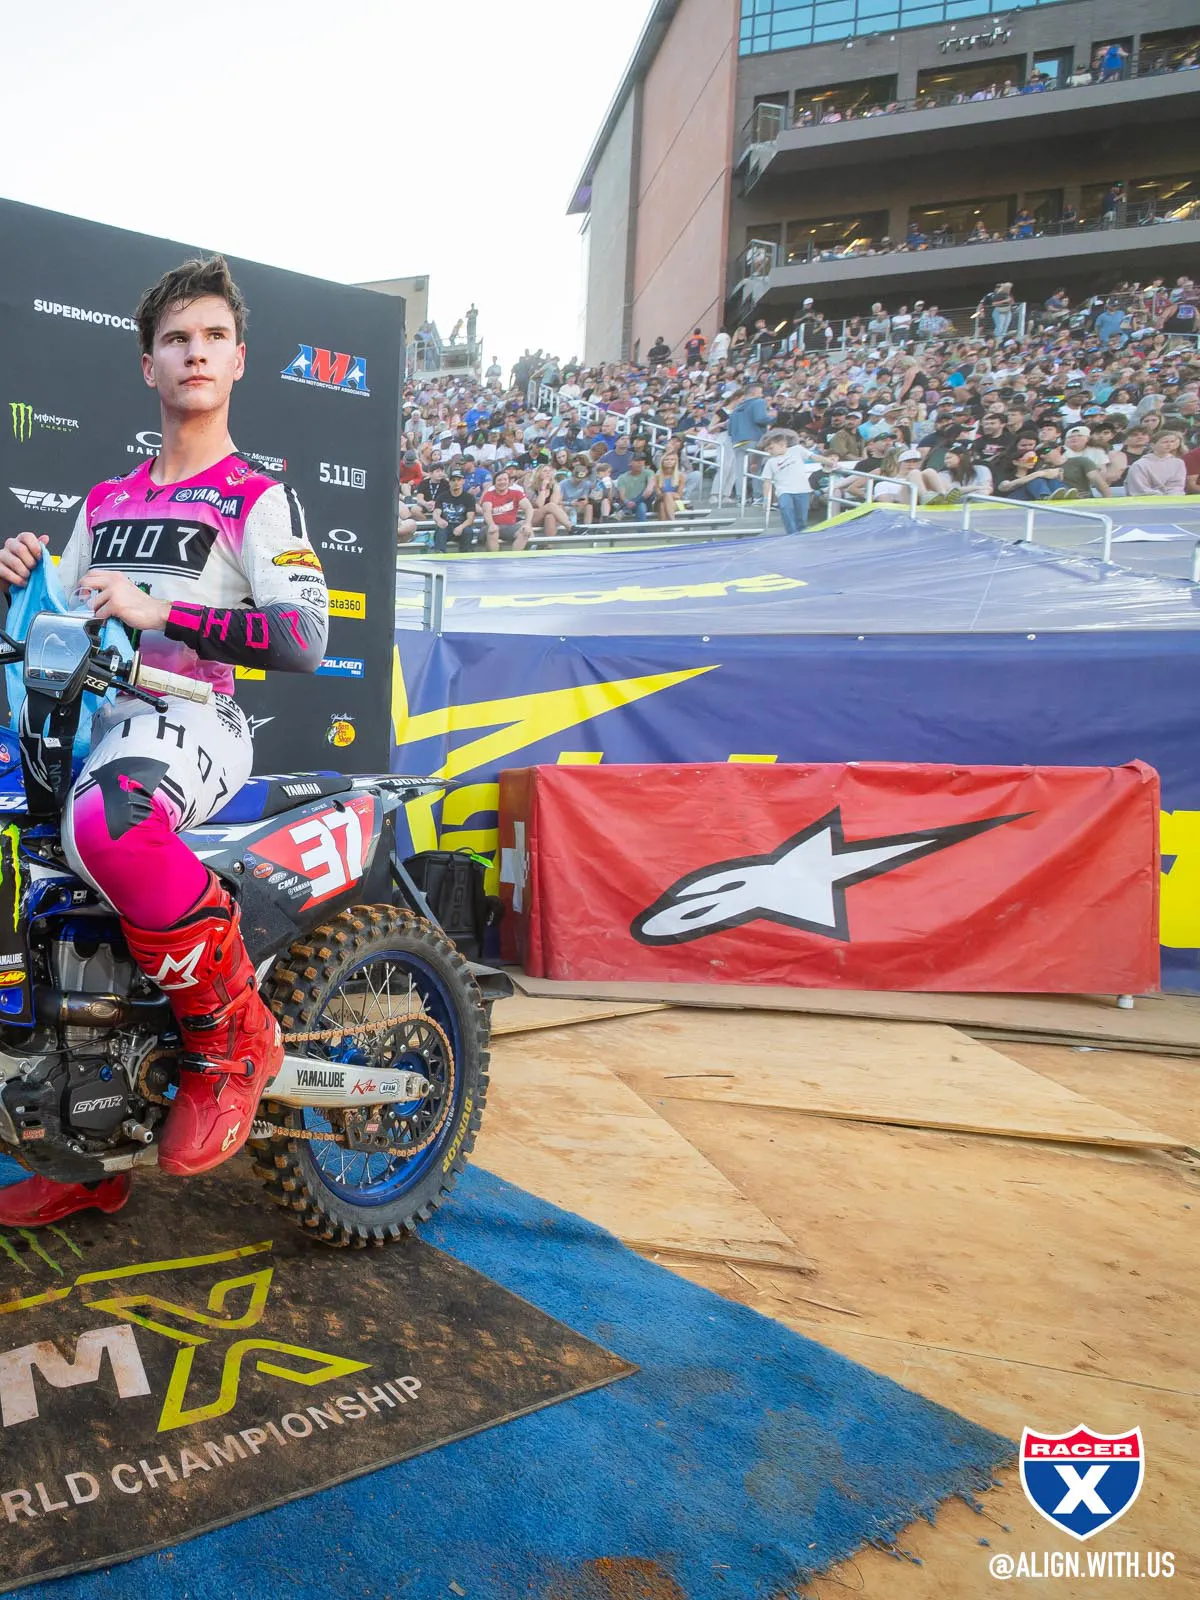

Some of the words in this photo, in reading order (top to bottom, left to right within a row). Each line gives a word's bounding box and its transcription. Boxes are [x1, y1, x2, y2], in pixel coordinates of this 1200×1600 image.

[280, 343, 371, 392] AMA
[33, 413, 80, 429] MONSTER
[40, 423, 73, 433] ENERGY
[126, 445, 161, 457] OAK
[319, 461, 351, 488] 5.11
[14, 487, 82, 509] FLY
[191, 488, 237, 516] YAMAHA
[23, 503, 67, 514] RACING
[321, 541, 364, 554] OAKLEY
[328, 599, 361, 612] sta360
[202, 607, 309, 651] HOR
[281, 782, 322, 797] YAMAHA
[288, 805, 363, 898] 37
[296, 1069, 345, 1089] YAMALUBE
[382, 1084, 397, 1092] AFAM
[72, 1094, 124, 1115] GYTR
[442, 1095, 473, 1173] DUNLOP
[110, 1374, 424, 1495] CHAMPIONSHIP
